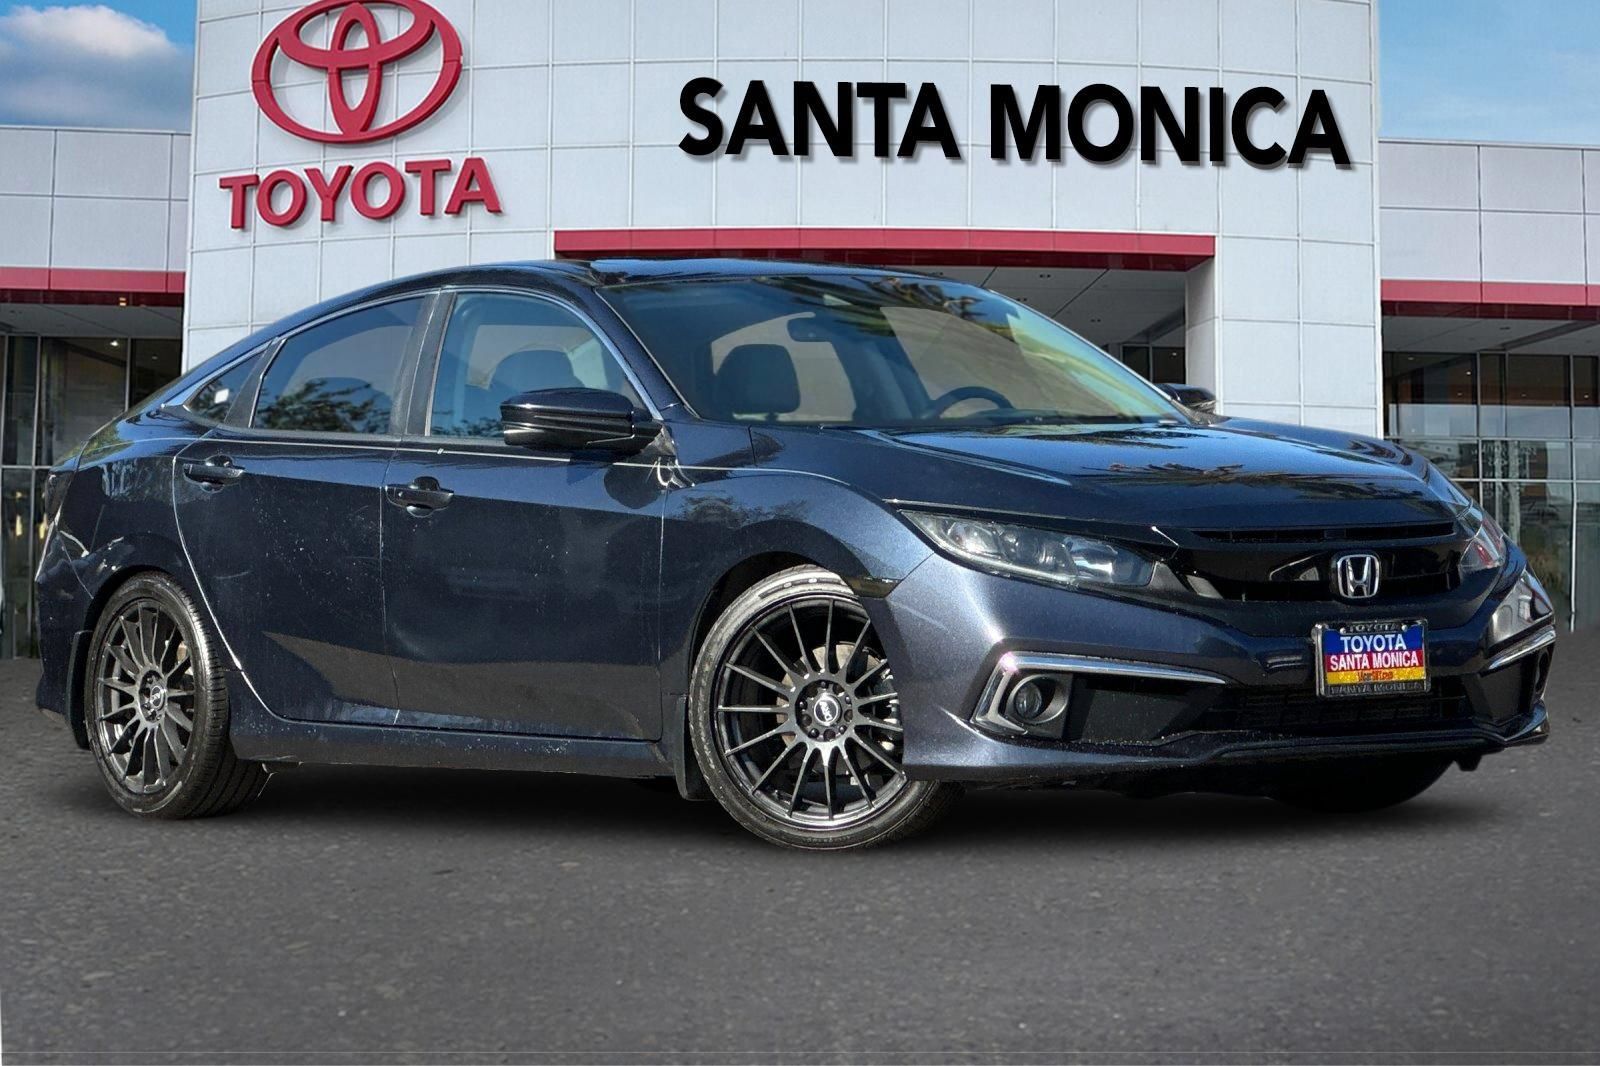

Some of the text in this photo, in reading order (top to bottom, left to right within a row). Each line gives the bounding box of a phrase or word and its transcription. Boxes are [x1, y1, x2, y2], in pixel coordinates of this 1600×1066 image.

[678, 76, 1352, 167] SANTA MONICA
[219, 157, 503, 230] TOYOTA
[1349, 622, 1398, 632] TOYOTA
[1340, 633, 1407, 653] TOYOTA
[1330, 650, 1419, 672] SANTA MONICA
